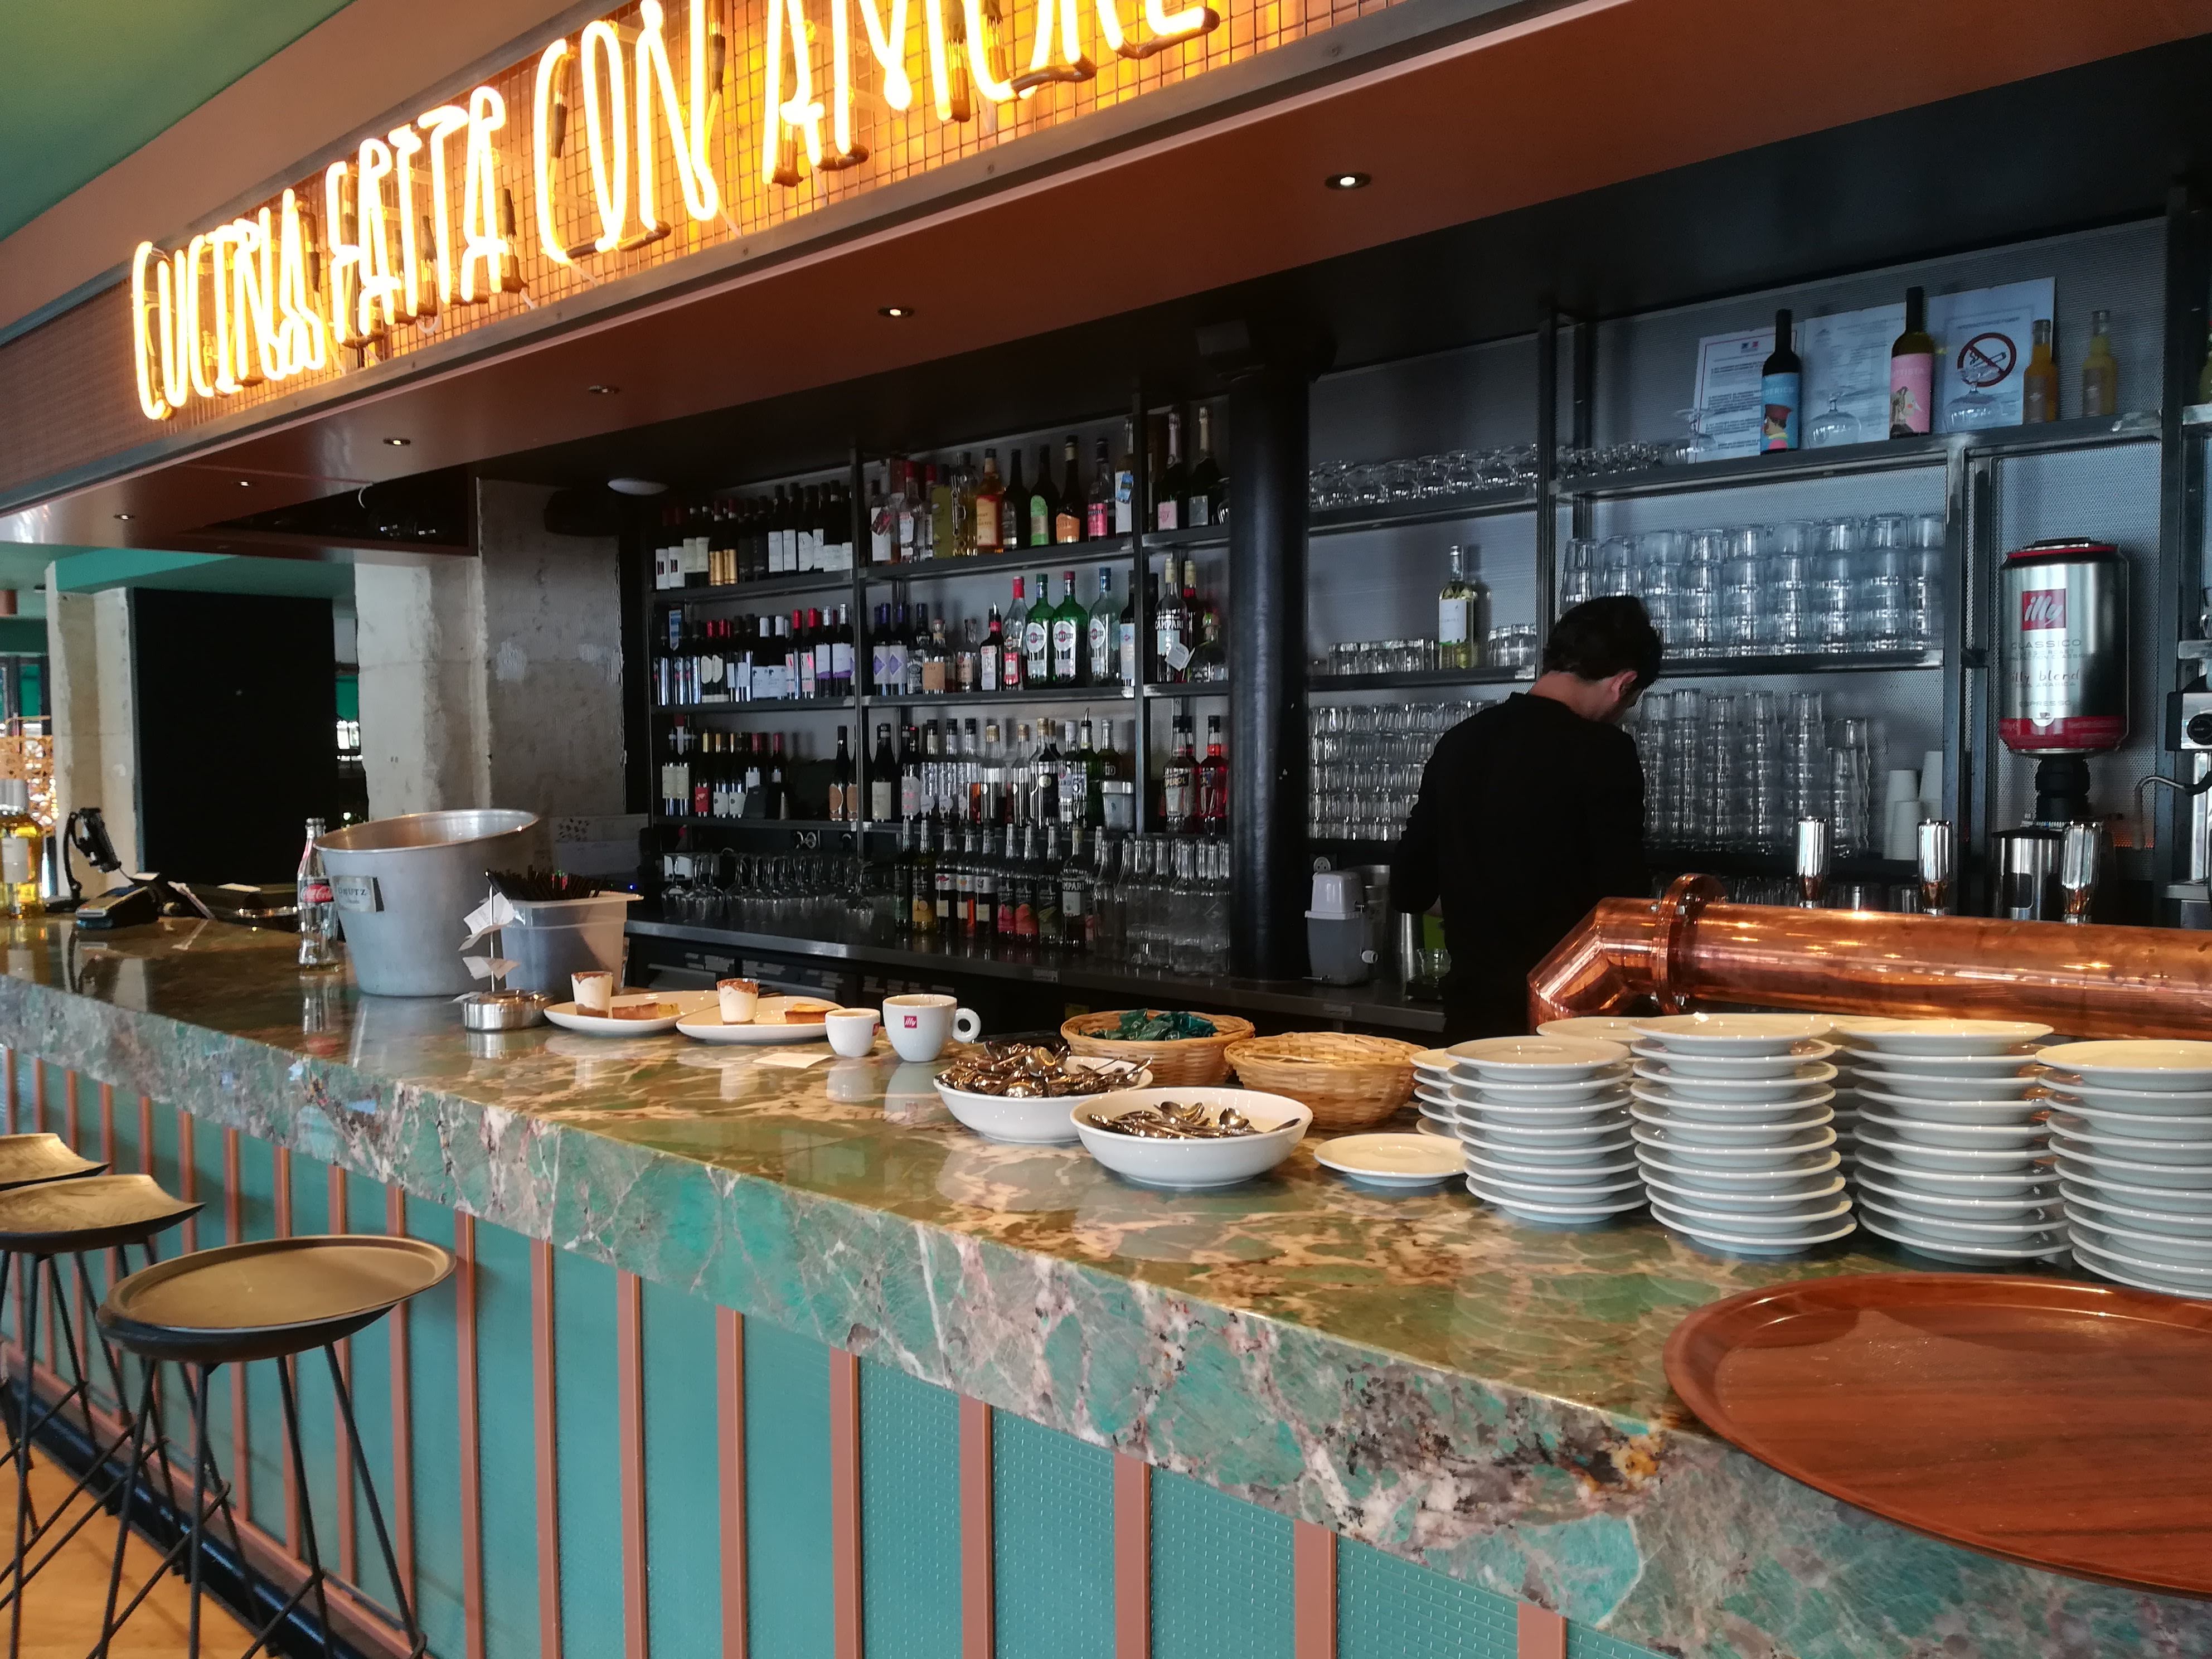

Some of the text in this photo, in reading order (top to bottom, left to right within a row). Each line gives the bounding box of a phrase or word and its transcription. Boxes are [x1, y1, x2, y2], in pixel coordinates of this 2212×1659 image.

[132, 188, 325, 420] CUCINA
[326, 86, 507, 342] FATTA
[532, 0, 719, 263] CON
[2024, 595, 2064, 625] illy
[1154, 619, 1183, 630] CAMPARI
[2011, 639, 2082, 649] CLASSICO
[2039, 668, 2080, 681] blend
[905, 1017, 916, 1027] illy
